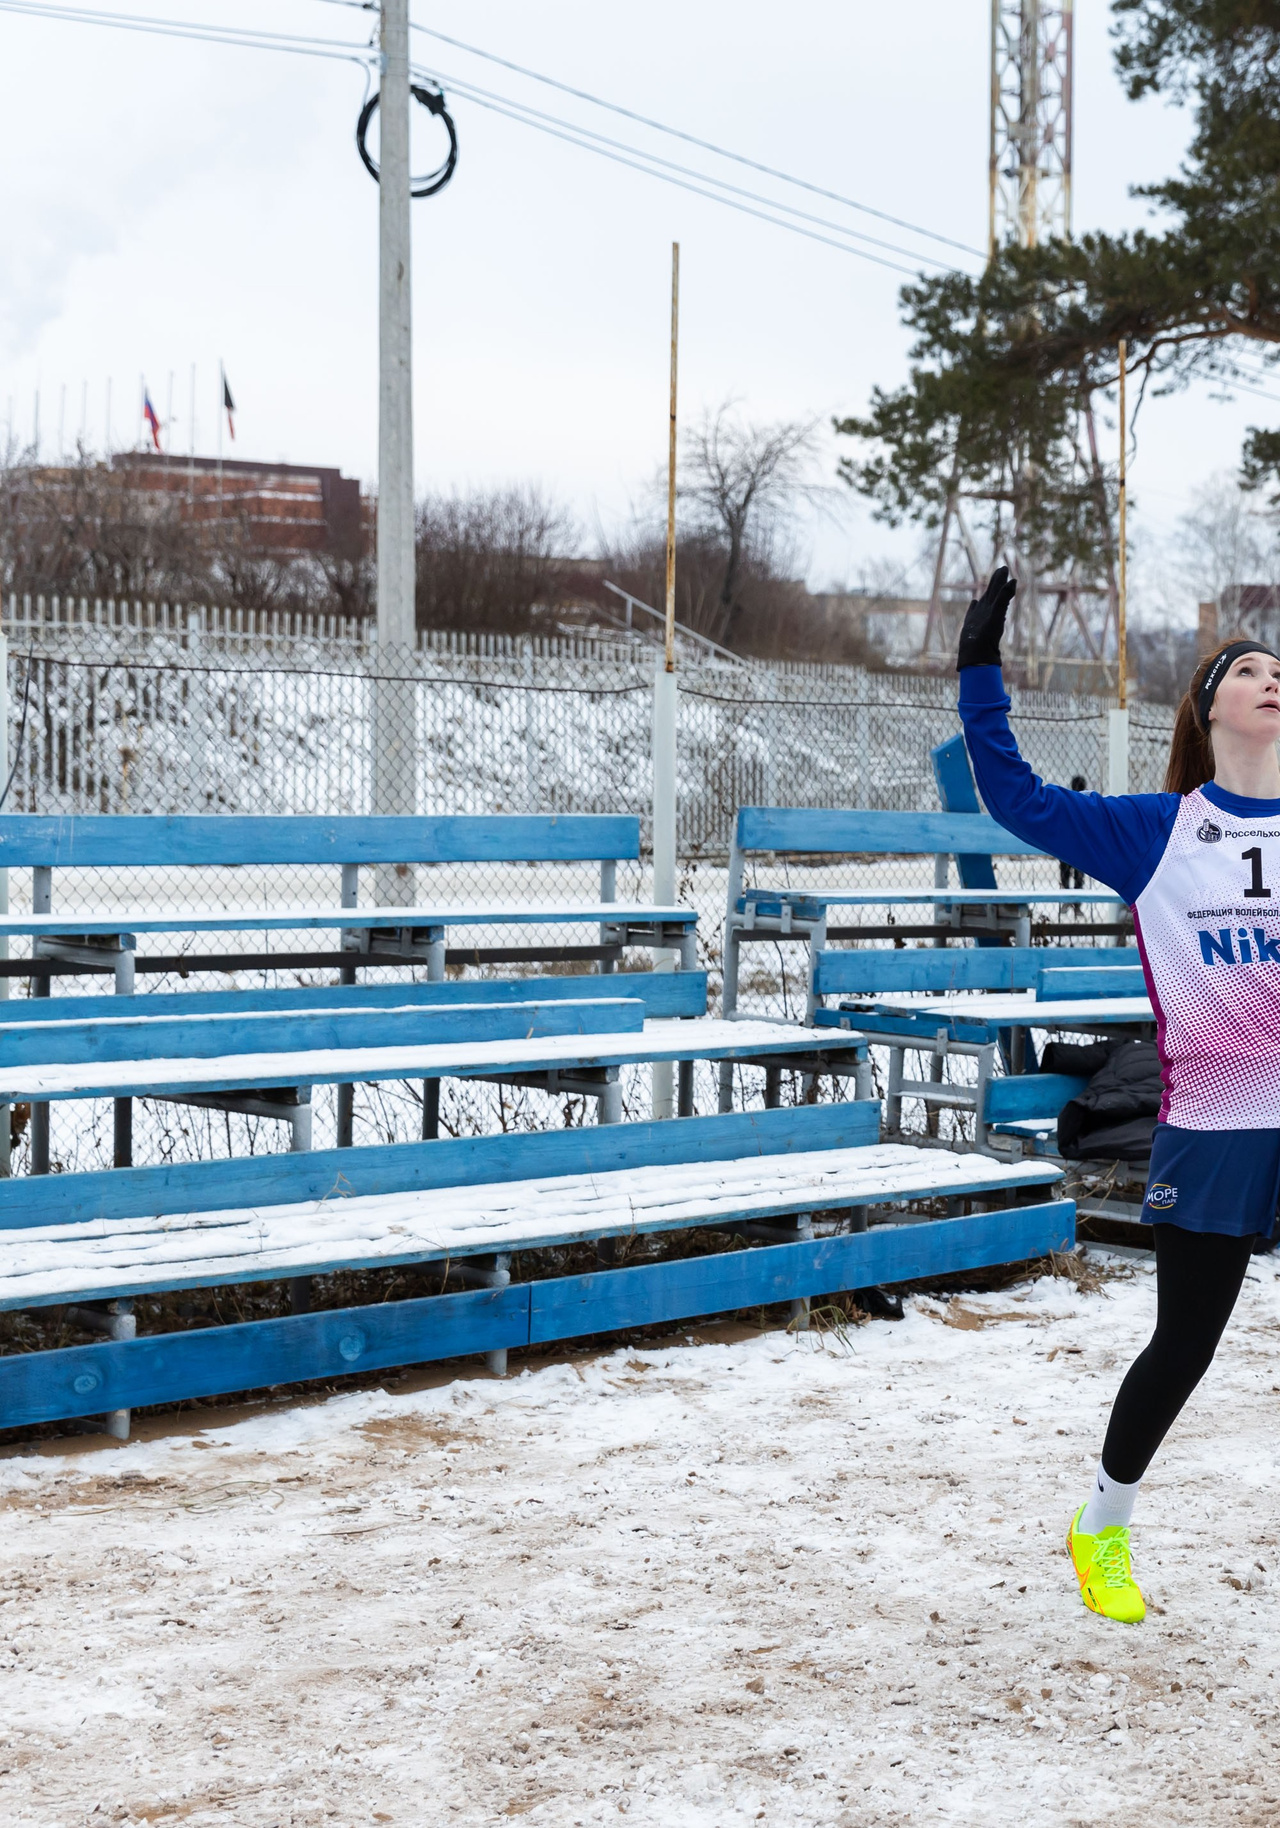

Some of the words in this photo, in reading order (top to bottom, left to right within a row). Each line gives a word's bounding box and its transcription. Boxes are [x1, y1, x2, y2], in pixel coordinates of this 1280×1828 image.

[1241, 846, 1272, 898] 1
[1187, 908, 1233, 919] ФЕДЕРАЦИЯ
[1146, 1188, 1178, 1202] МОРЕ
